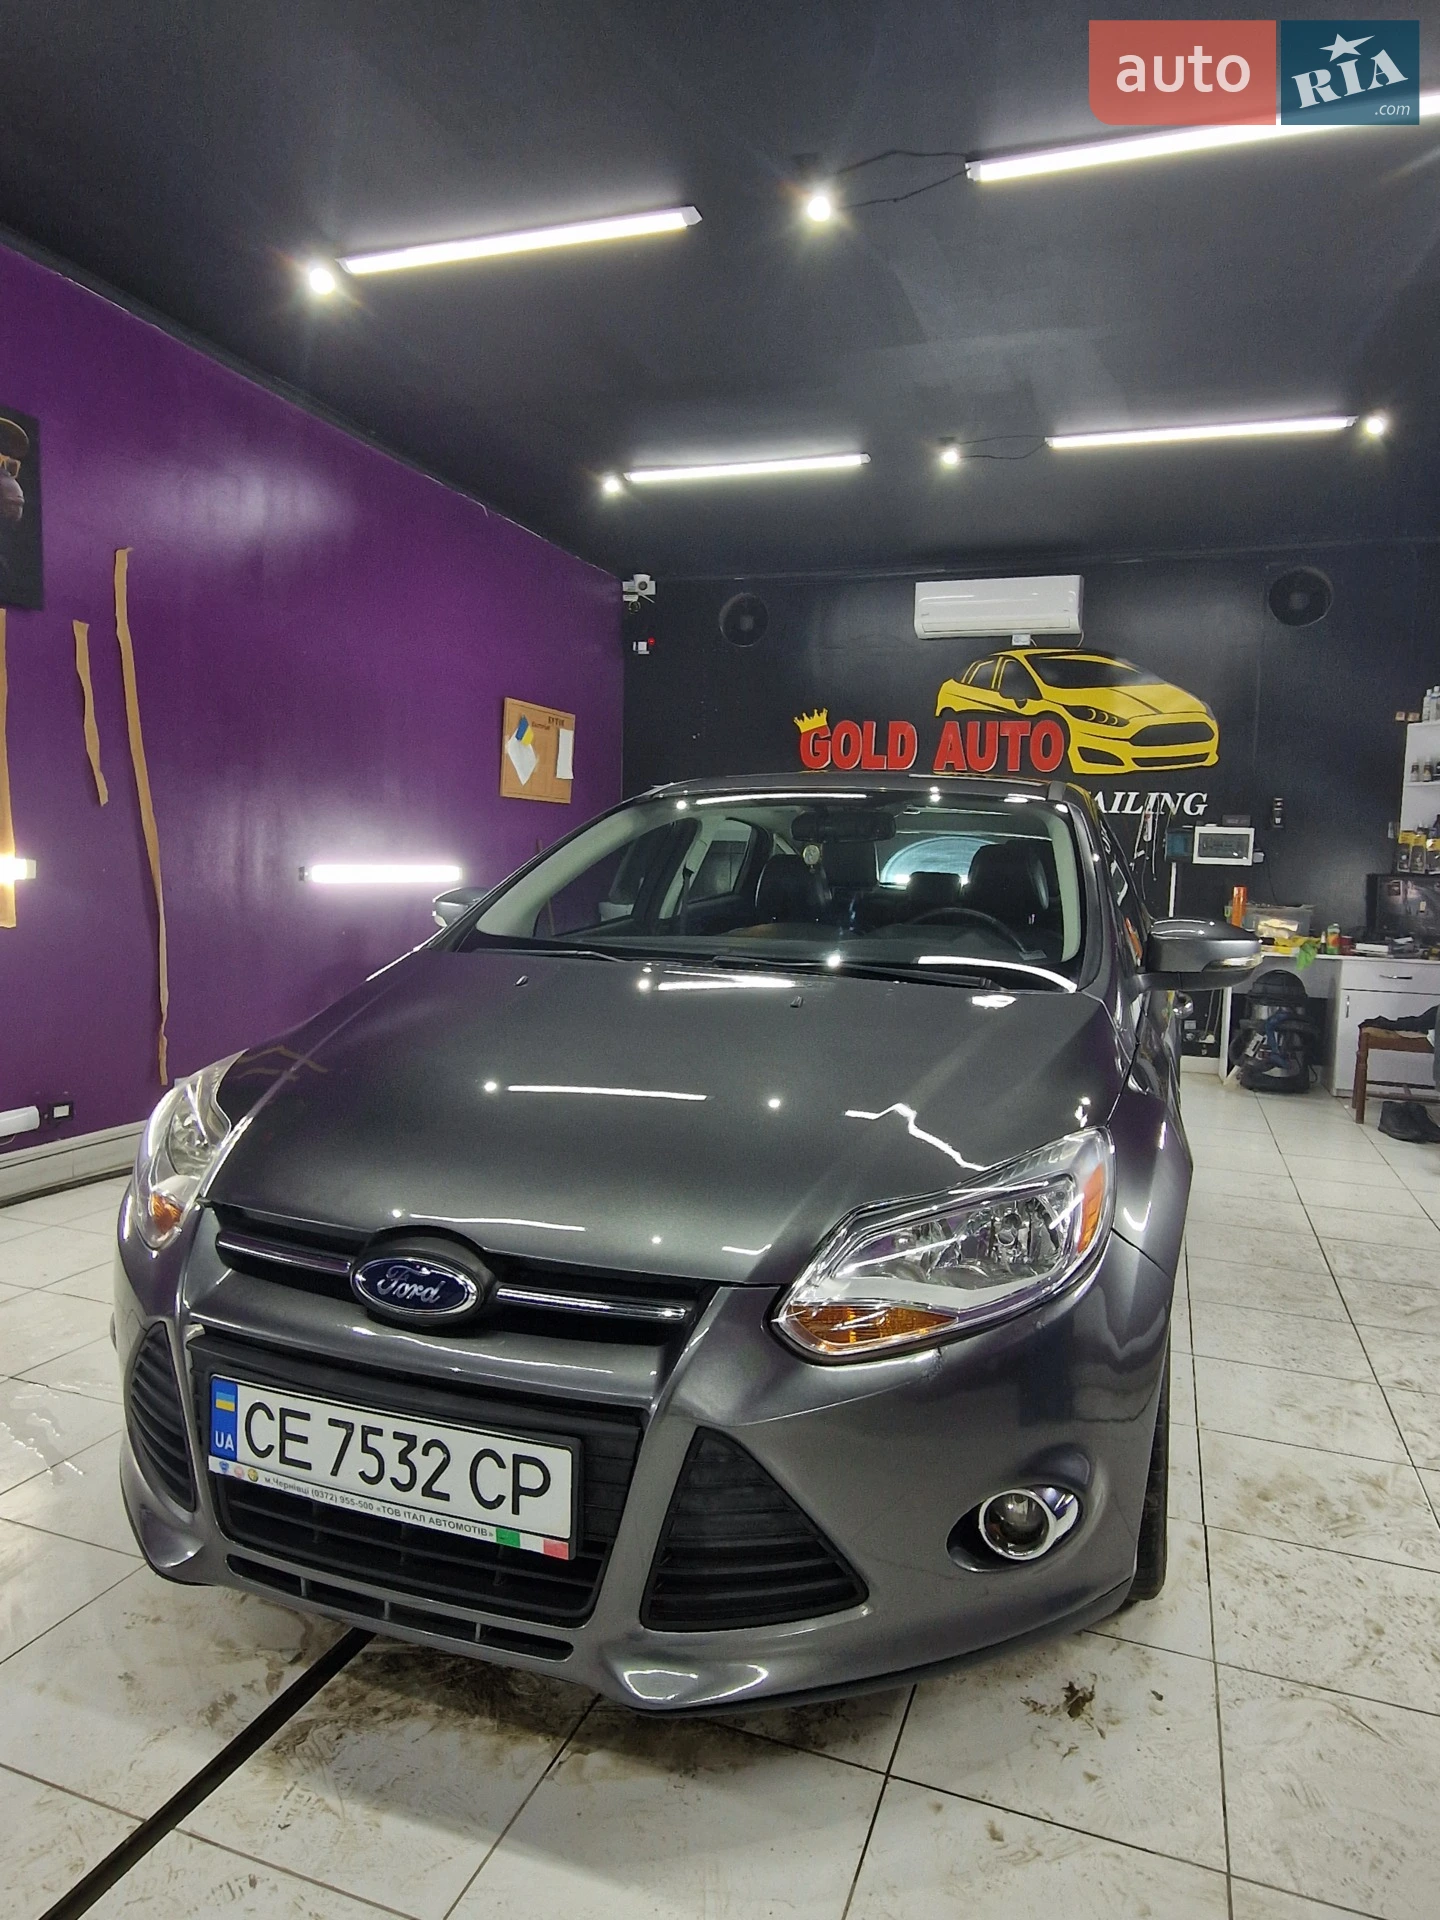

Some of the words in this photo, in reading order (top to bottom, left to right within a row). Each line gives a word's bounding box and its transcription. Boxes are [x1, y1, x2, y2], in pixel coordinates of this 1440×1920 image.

[800, 719, 918, 770] GOLD
[932, 719, 1065, 773] AUTO
[1089, 791, 1208, 816] AILING
[377, 1265, 446, 1303] Ford
[215, 1430, 235, 1452] UA
[245, 1401, 312, 1471] CE
[327, 1418, 452, 1502] 7532
[468, 1448, 551, 1515] CP
[311, 1489, 337, 1503] (0372)
[340, 1496, 374, 1511] 955-500
